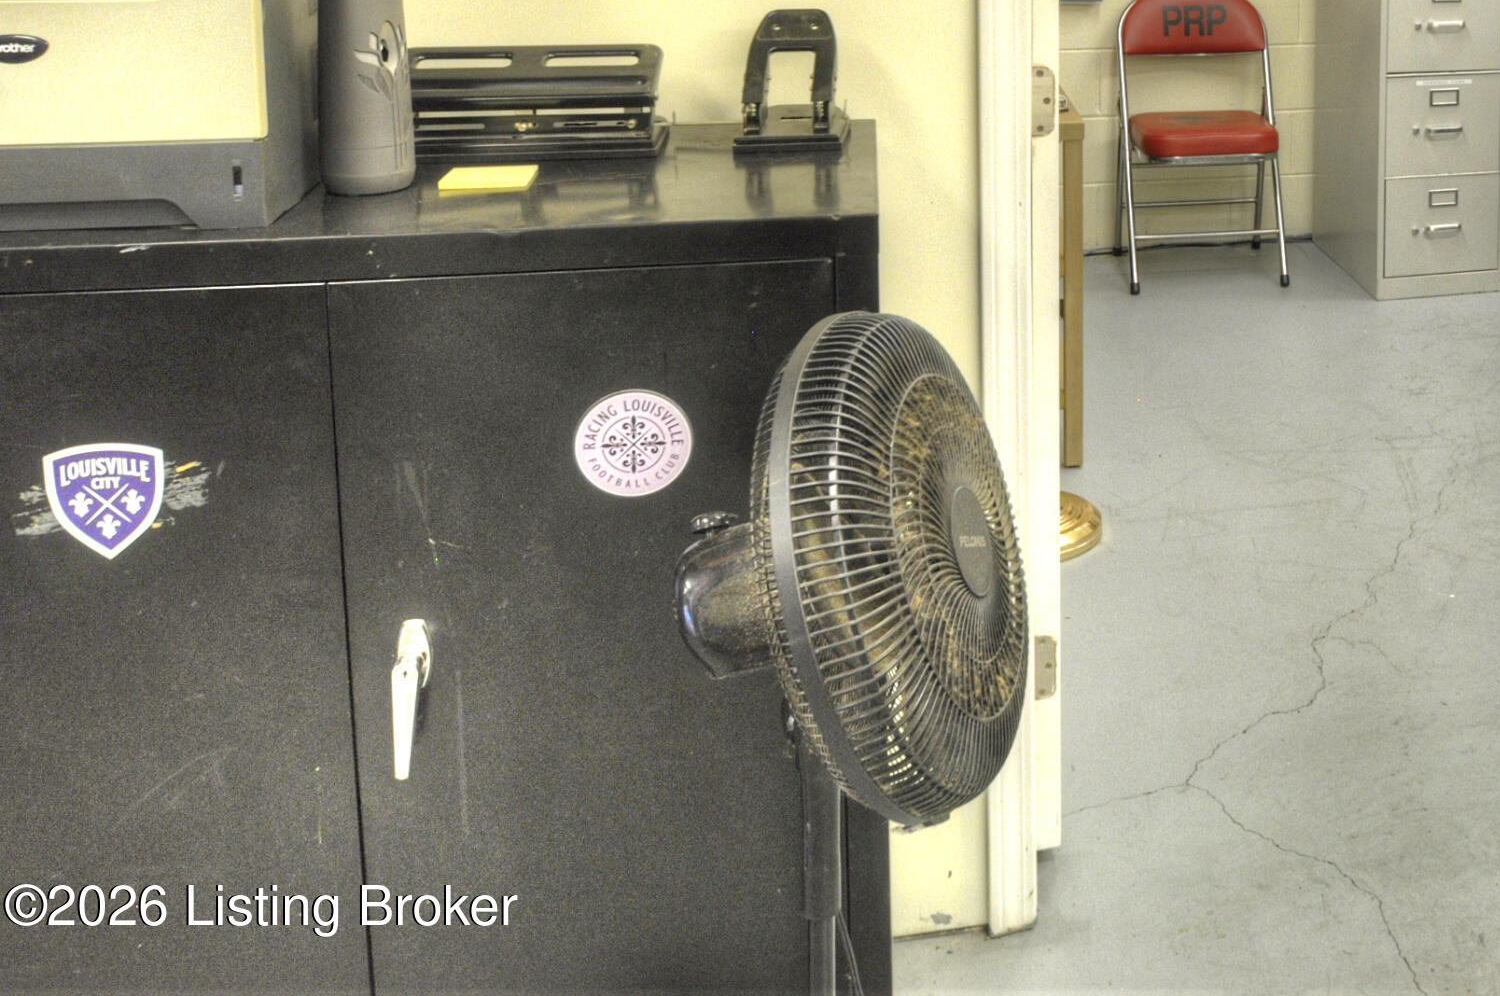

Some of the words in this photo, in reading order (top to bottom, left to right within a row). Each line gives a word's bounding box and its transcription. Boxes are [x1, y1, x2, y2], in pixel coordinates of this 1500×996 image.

[1161, 5, 1227, 37] PRP
[583, 404, 618, 450] RACING
[623, 399, 684, 446] LOUISVILLE
[59, 457, 151, 487] LOUISVILLE
[90, 476, 121, 490] CITY
[588, 458, 650, 488] FOOTBALL
[655, 453, 680, 480] CLUB
